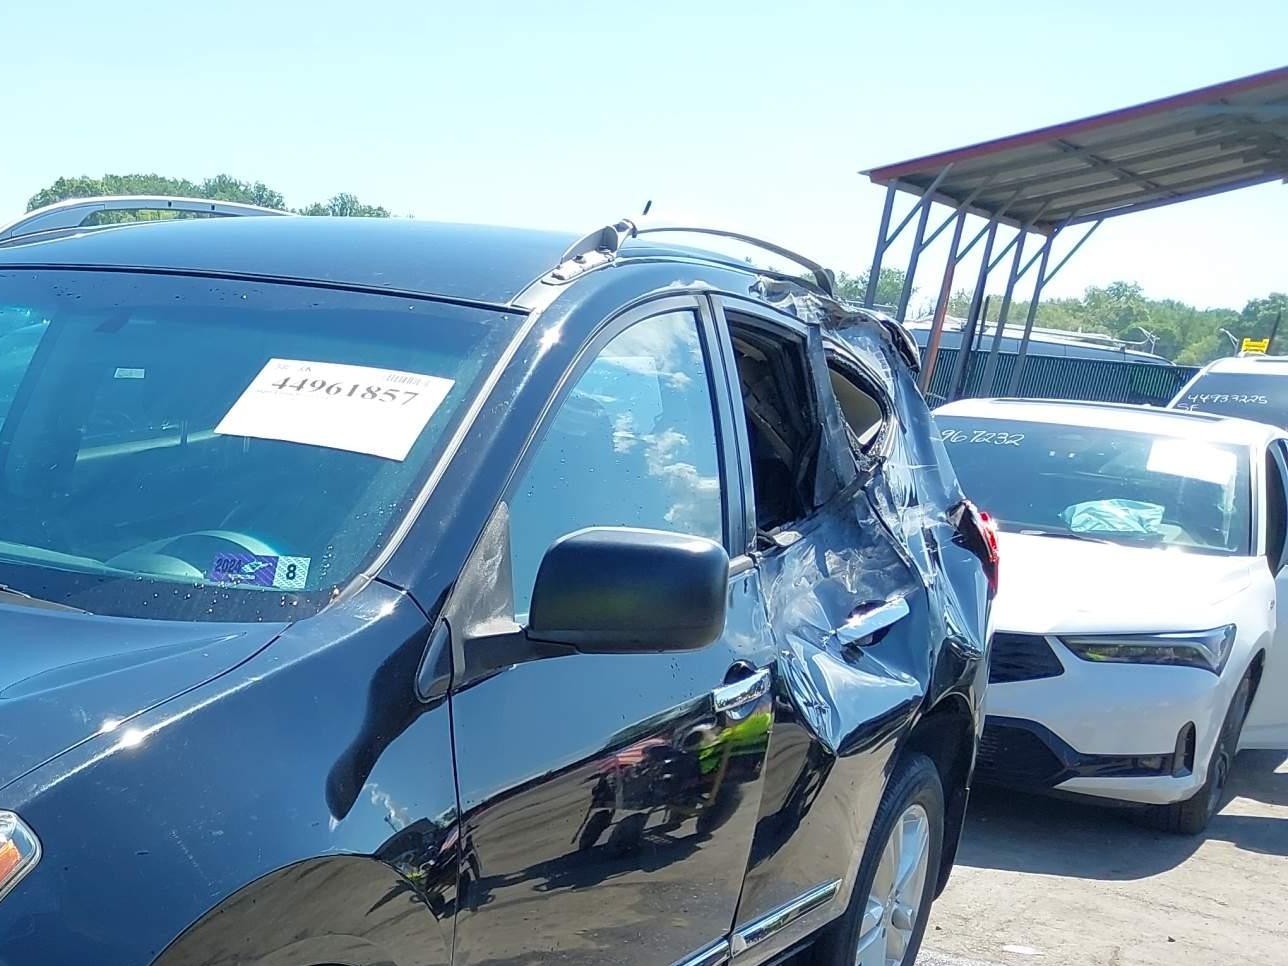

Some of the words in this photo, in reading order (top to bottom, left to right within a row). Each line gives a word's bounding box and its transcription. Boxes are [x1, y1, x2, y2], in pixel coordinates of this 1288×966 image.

[271, 376, 420, 406] 44961857
[214, 558, 244, 574] 2024
[285, 563, 298, 581] 8
